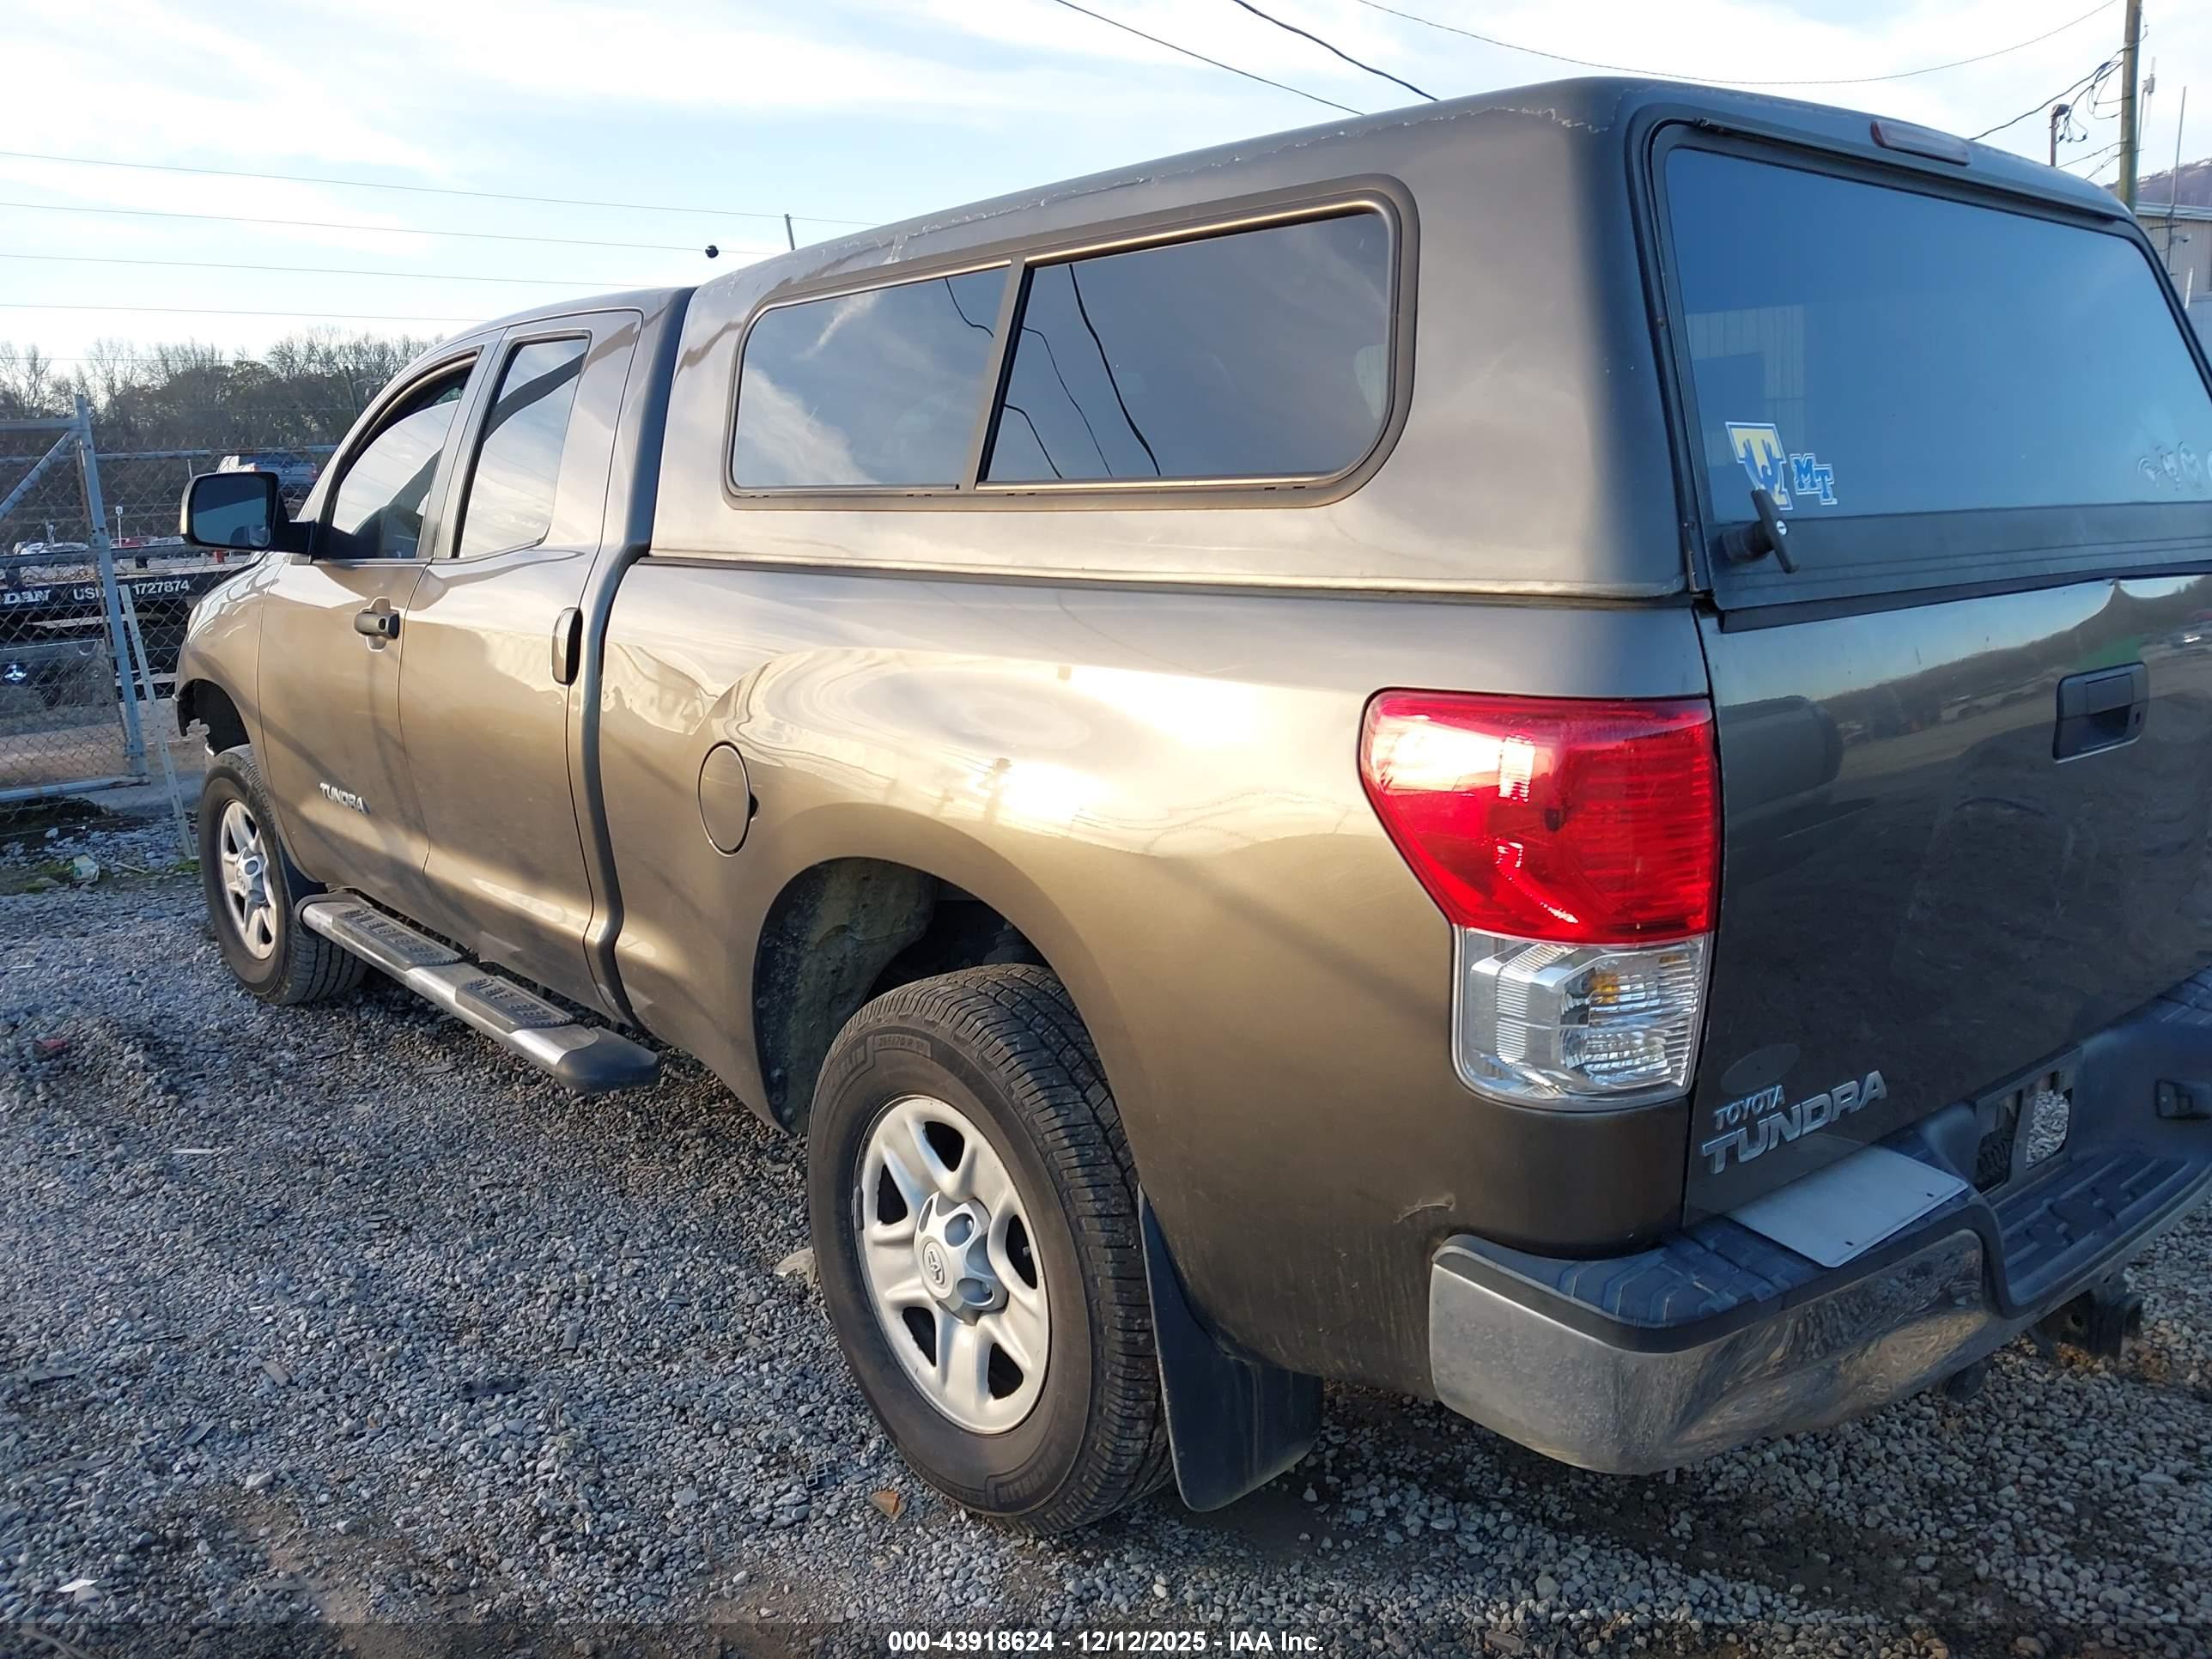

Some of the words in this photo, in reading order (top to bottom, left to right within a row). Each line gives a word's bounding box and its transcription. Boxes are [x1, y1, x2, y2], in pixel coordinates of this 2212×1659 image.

[132, 579, 191, 596] 1727874
[319, 781, 371, 814] TUNDRA
[1701, 1070, 1888, 1175] TUNDRA
[1713, 1085, 1787, 1131] TOYOTA
